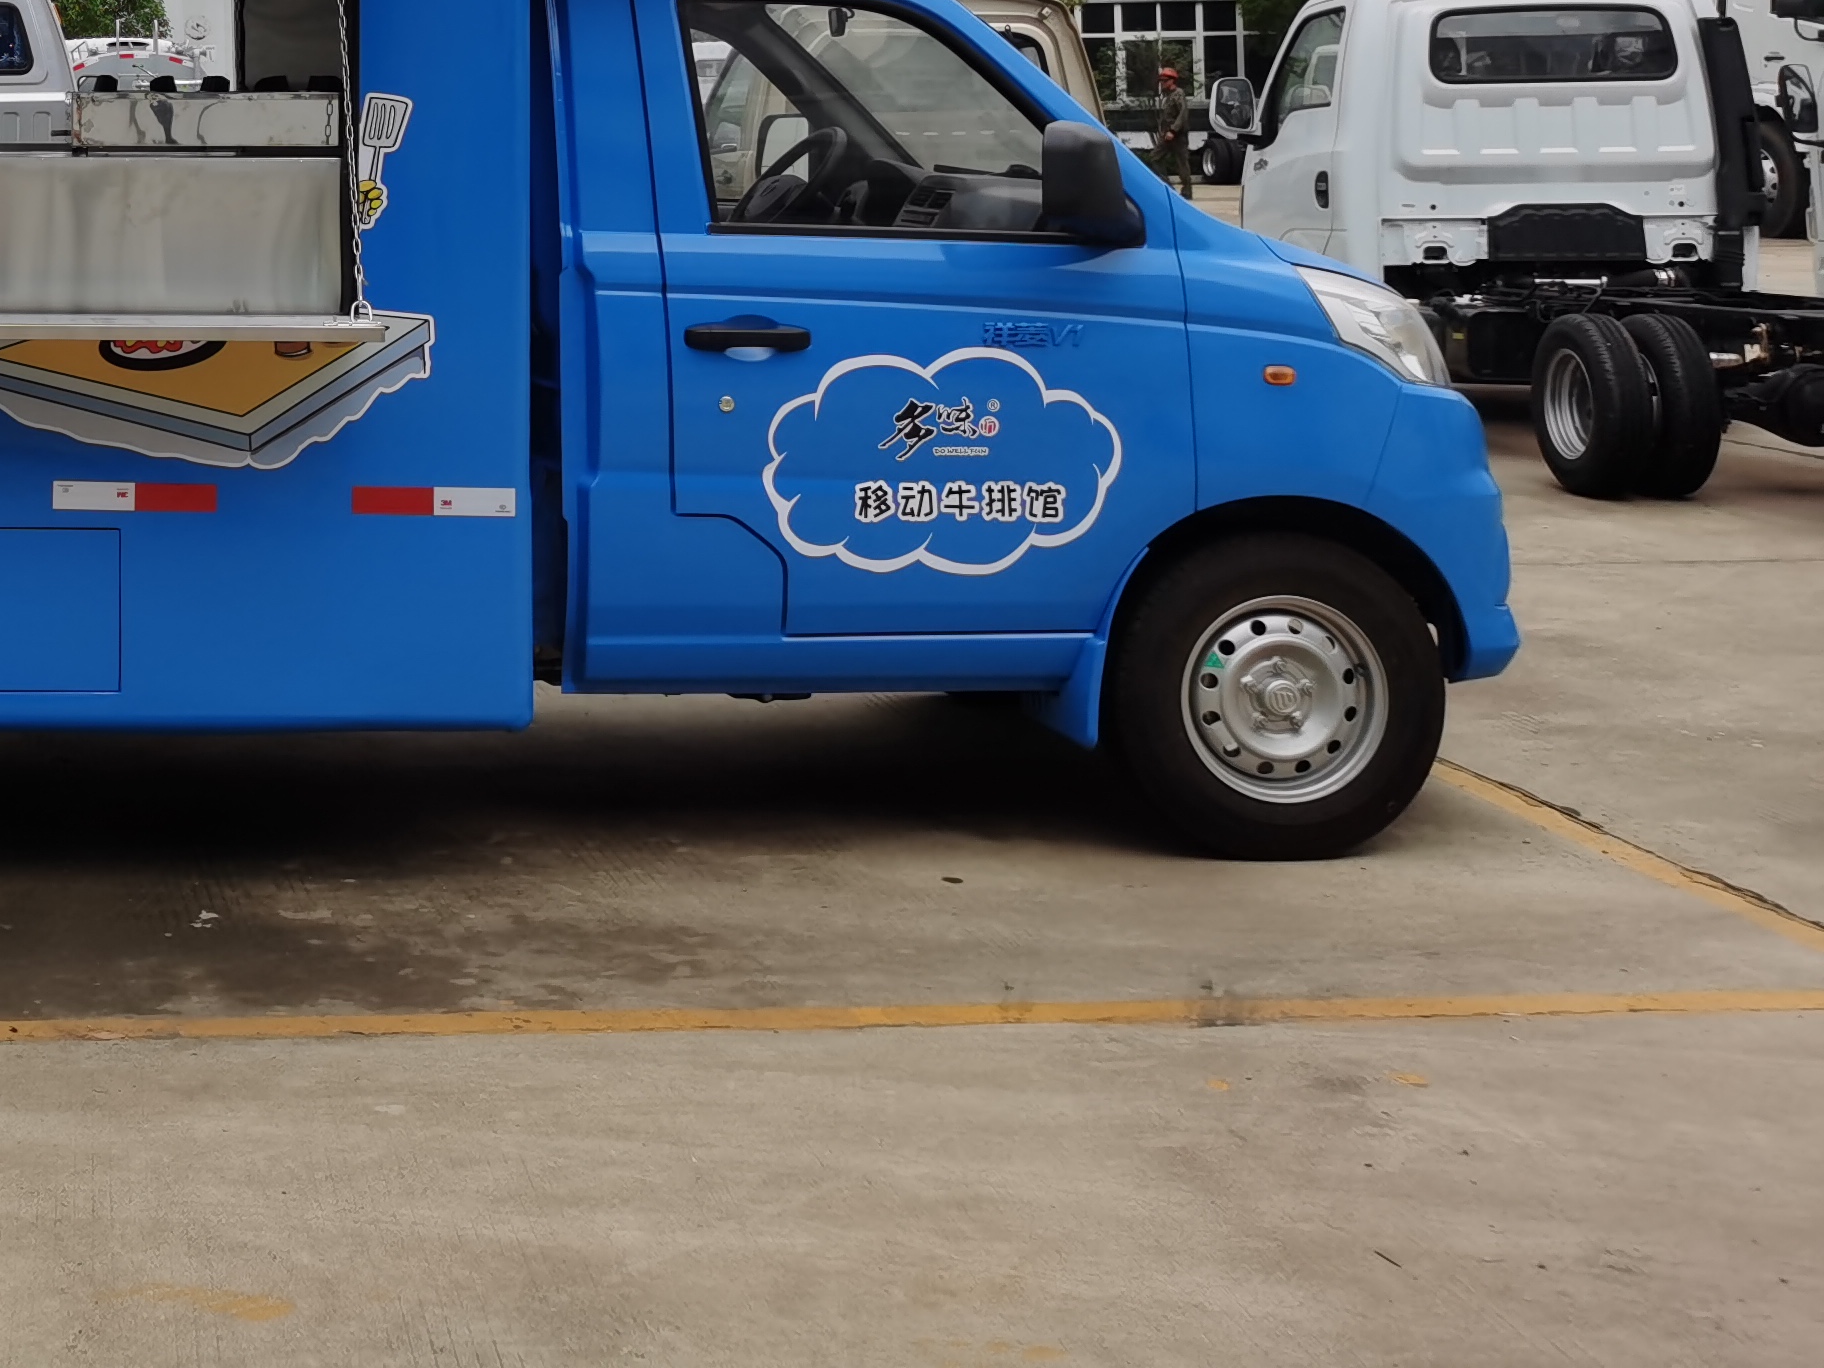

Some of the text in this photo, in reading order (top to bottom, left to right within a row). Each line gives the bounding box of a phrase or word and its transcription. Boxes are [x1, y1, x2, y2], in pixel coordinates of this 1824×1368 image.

[946, 447, 969, 455] WELL
[858, 484, 1063, 520] 移动牛排馆
